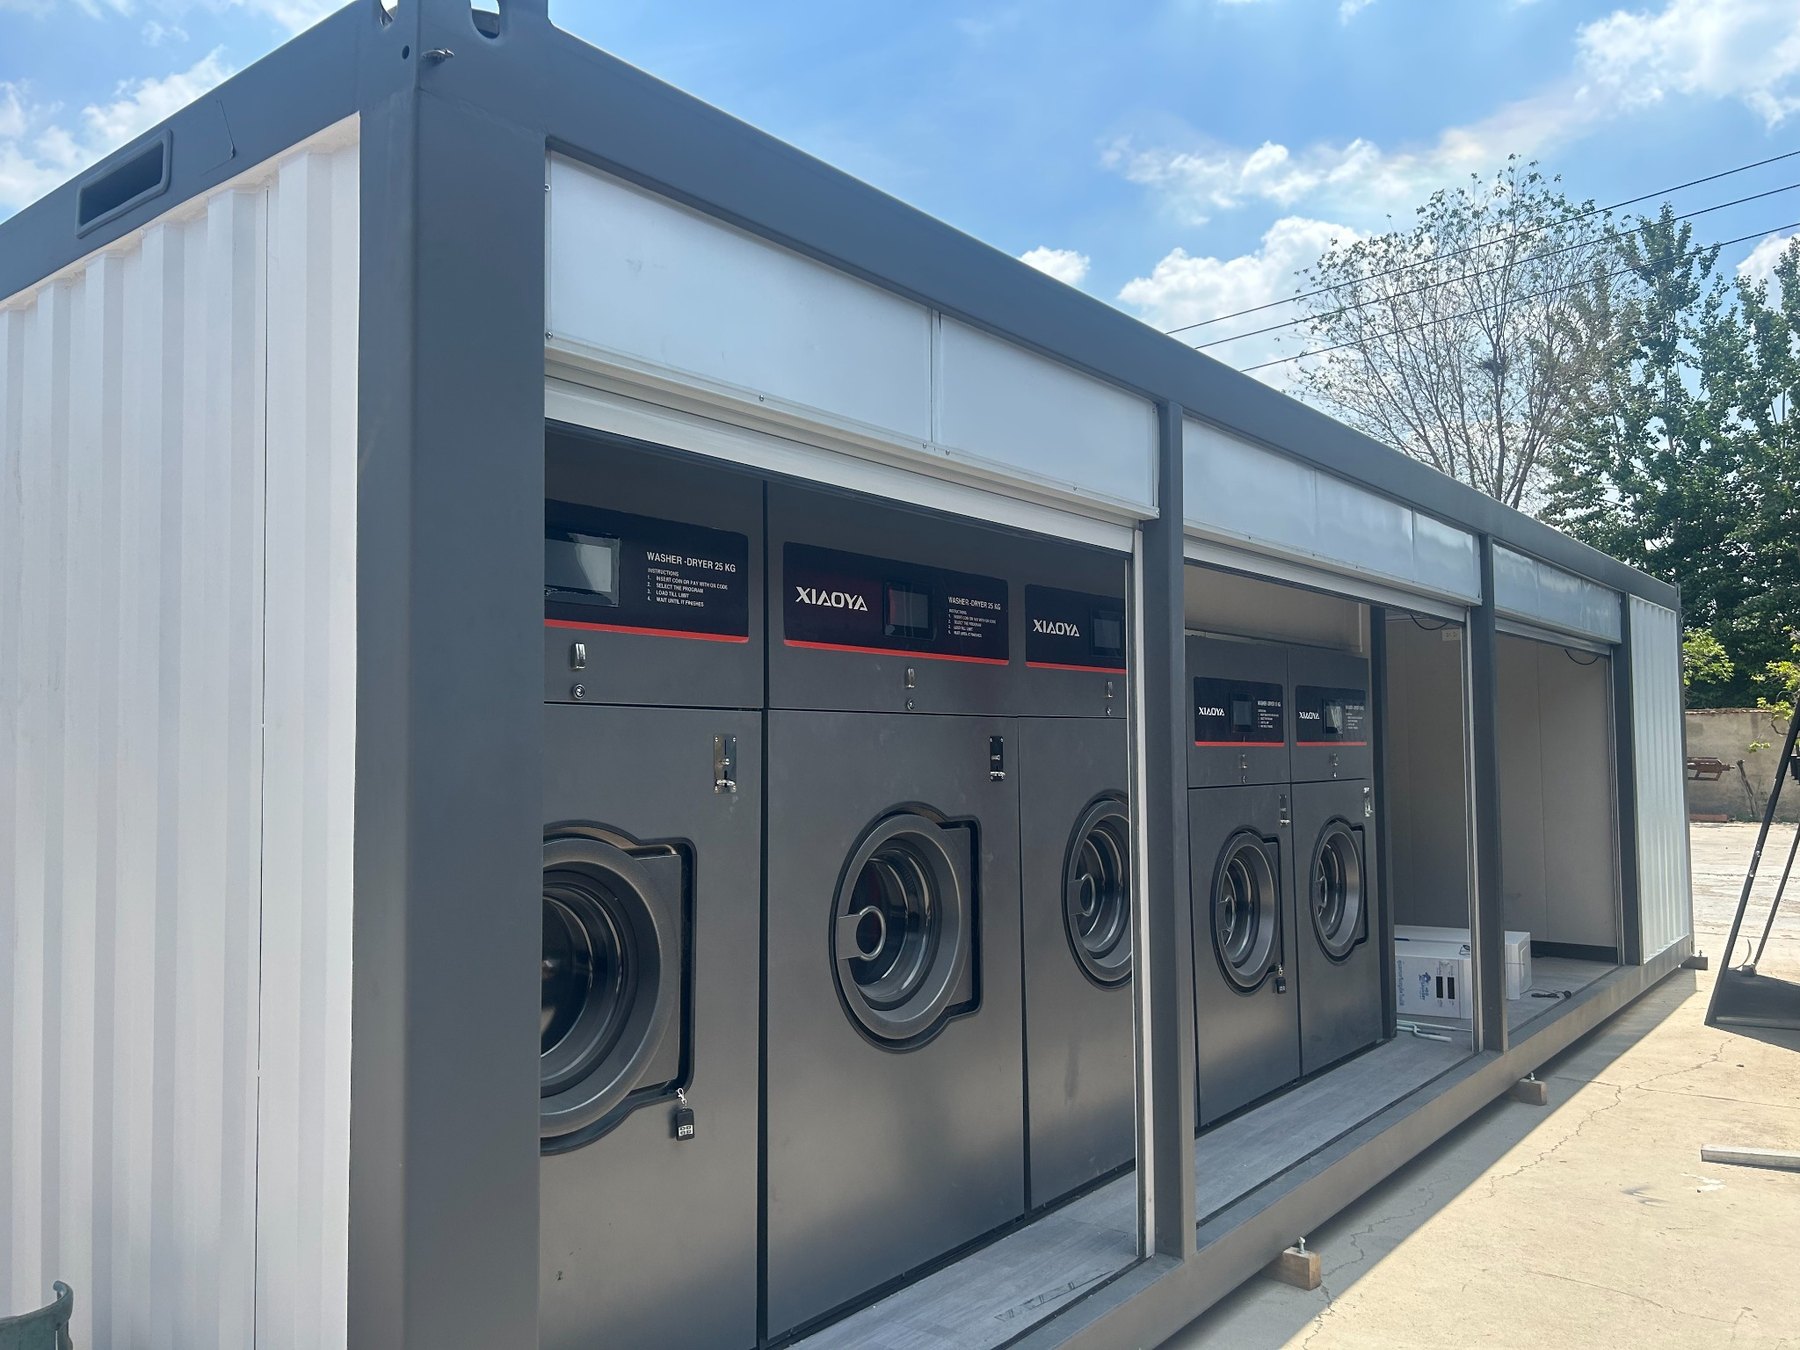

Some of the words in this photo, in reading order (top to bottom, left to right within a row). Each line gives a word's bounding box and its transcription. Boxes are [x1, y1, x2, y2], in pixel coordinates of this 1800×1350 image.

[647, 552, 682, 564] WASHER
[715, 562, 723, 570] 25
[725, 563, 736, 572] KG
[648, 568, 679, 576] INSTRUCTIONS
[796, 586, 868, 612] XIAOYA
[948, 596, 969, 605] WASHER
[1033, 619, 1080, 637] XIAOYA
[1198, 706, 1225, 716] XIAOYA
